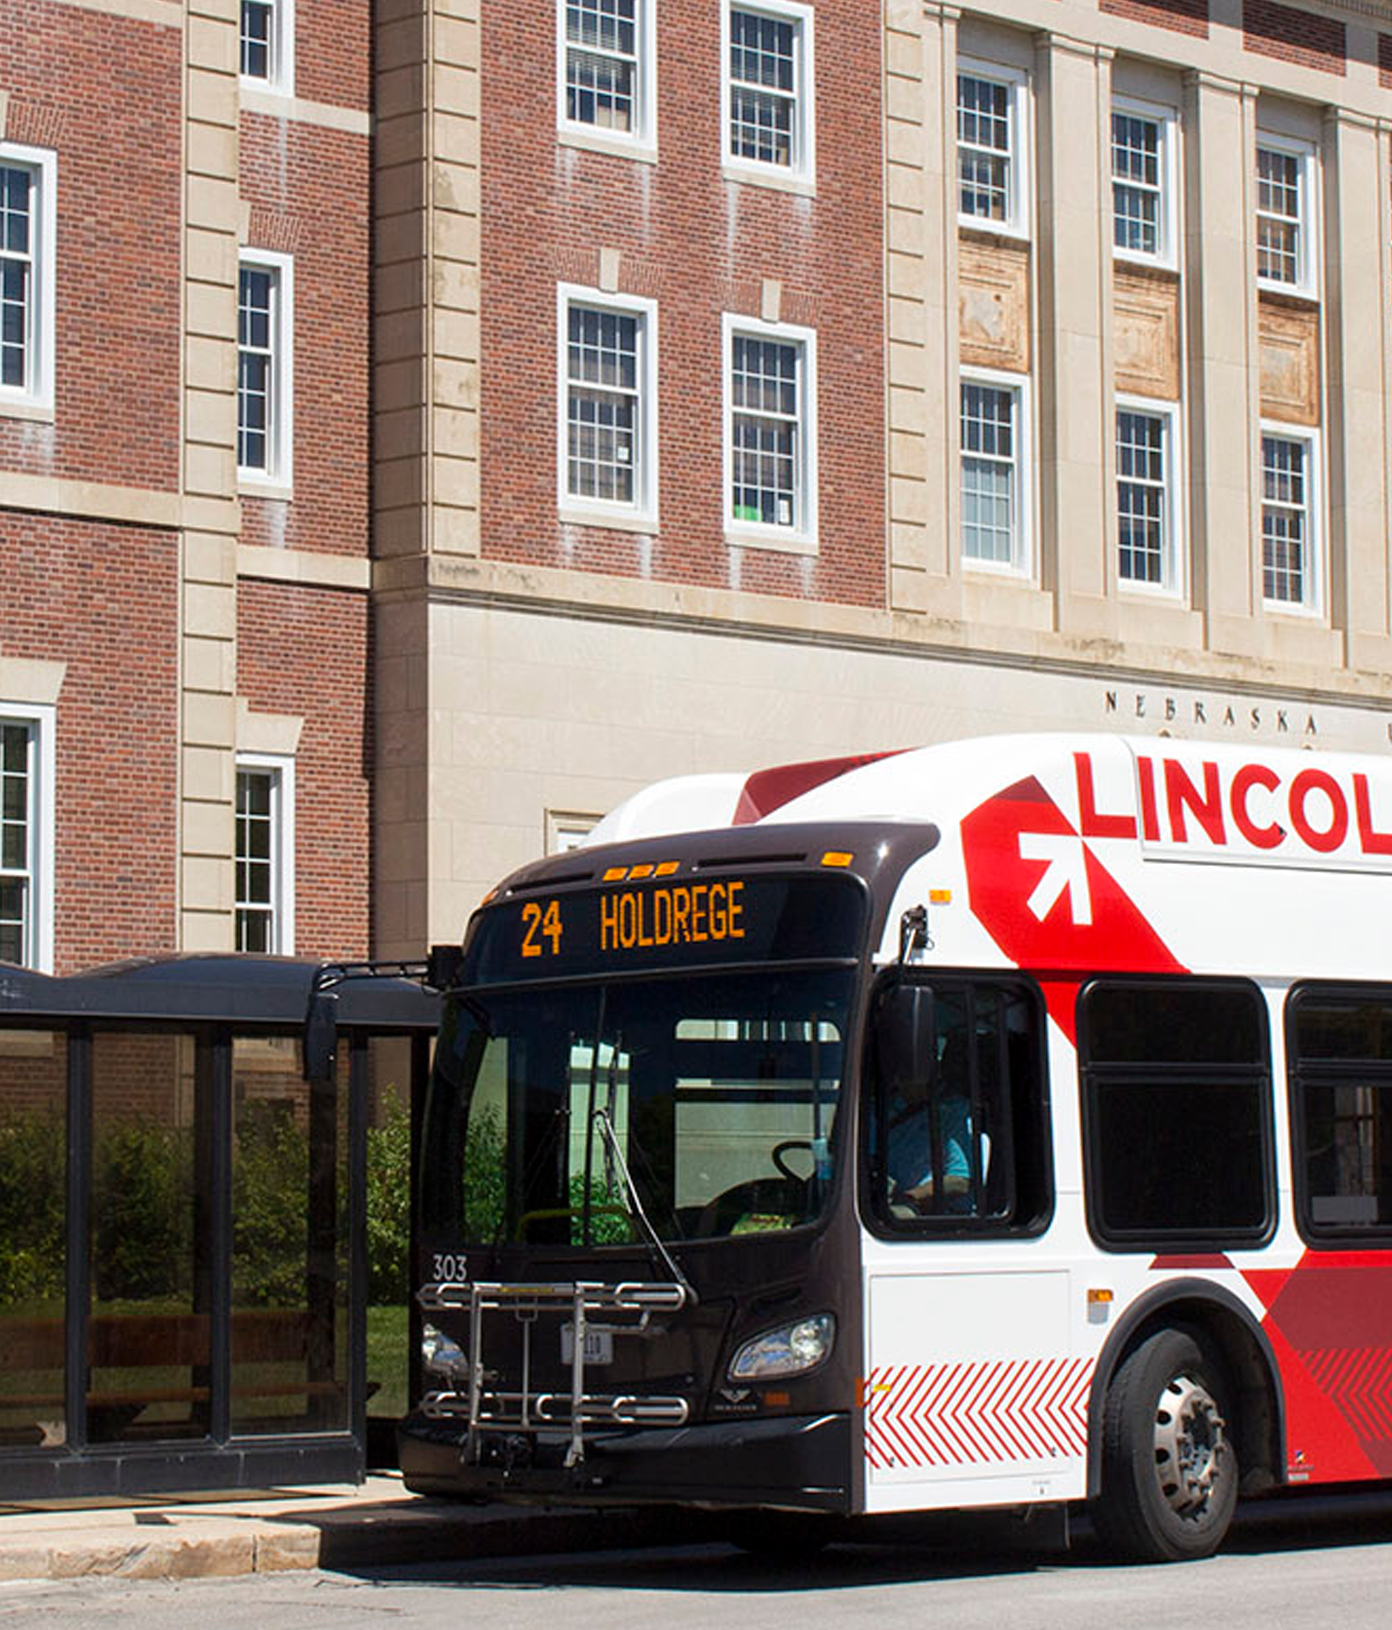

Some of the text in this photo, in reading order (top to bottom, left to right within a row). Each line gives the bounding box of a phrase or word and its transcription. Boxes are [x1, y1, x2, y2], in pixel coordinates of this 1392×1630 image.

[1105, 690, 1317, 735] NEBRASKA
[521, 881, 746, 957] 24 HOLDREGE
[432, 1254, 468, 1281] 303
